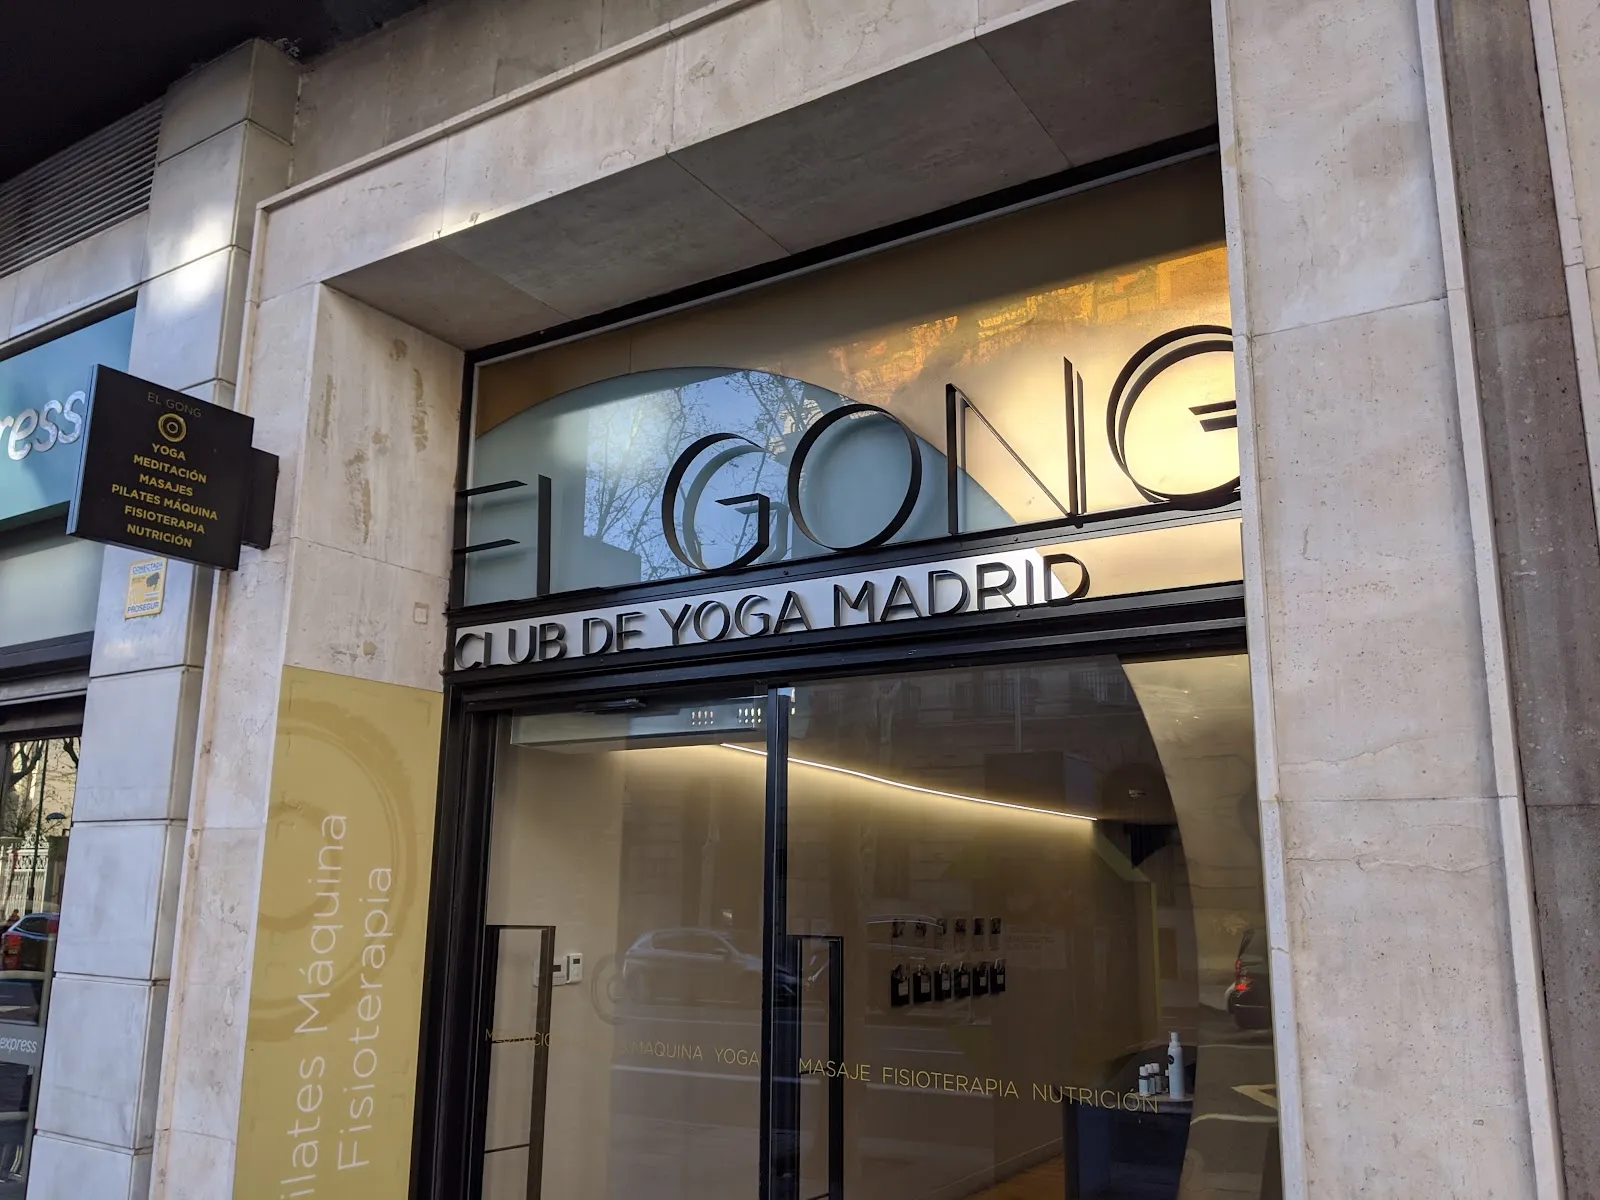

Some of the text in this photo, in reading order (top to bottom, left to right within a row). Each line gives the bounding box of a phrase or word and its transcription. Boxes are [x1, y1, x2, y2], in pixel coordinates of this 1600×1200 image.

[147, 391, 202, 418] EL GONG
[152, 443, 186, 461] YOGA
[453, 325, 1241, 608] EL GONG
[133, 454, 207, 483] MEDITACIÓN
[139, 473, 193, 497] MASAJES
[111, 483, 218, 521] PILATES MÁQUINA
[124, 505, 206, 534] FISIOTERAPIA
[126, 523, 193, 548] NUTRICIÓN
[127, 601, 160, 613] PROSEGUR
[454, 553, 1091, 670] CLUB DE YOGA MADRID
[280, 814, 348, 1200] ilates Máquina
[337, 867, 394, 1171] Fisioterapia
[0, 1037, 38, 1054] express
[714, 1047, 760, 1066] YOGA
[798, 1057, 871, 1083] MASAJE
[882, 1066, 1020, 1100] FISIOTERAPIA
[1032, 1082, 1159, 1115] NUTRICIÓN
